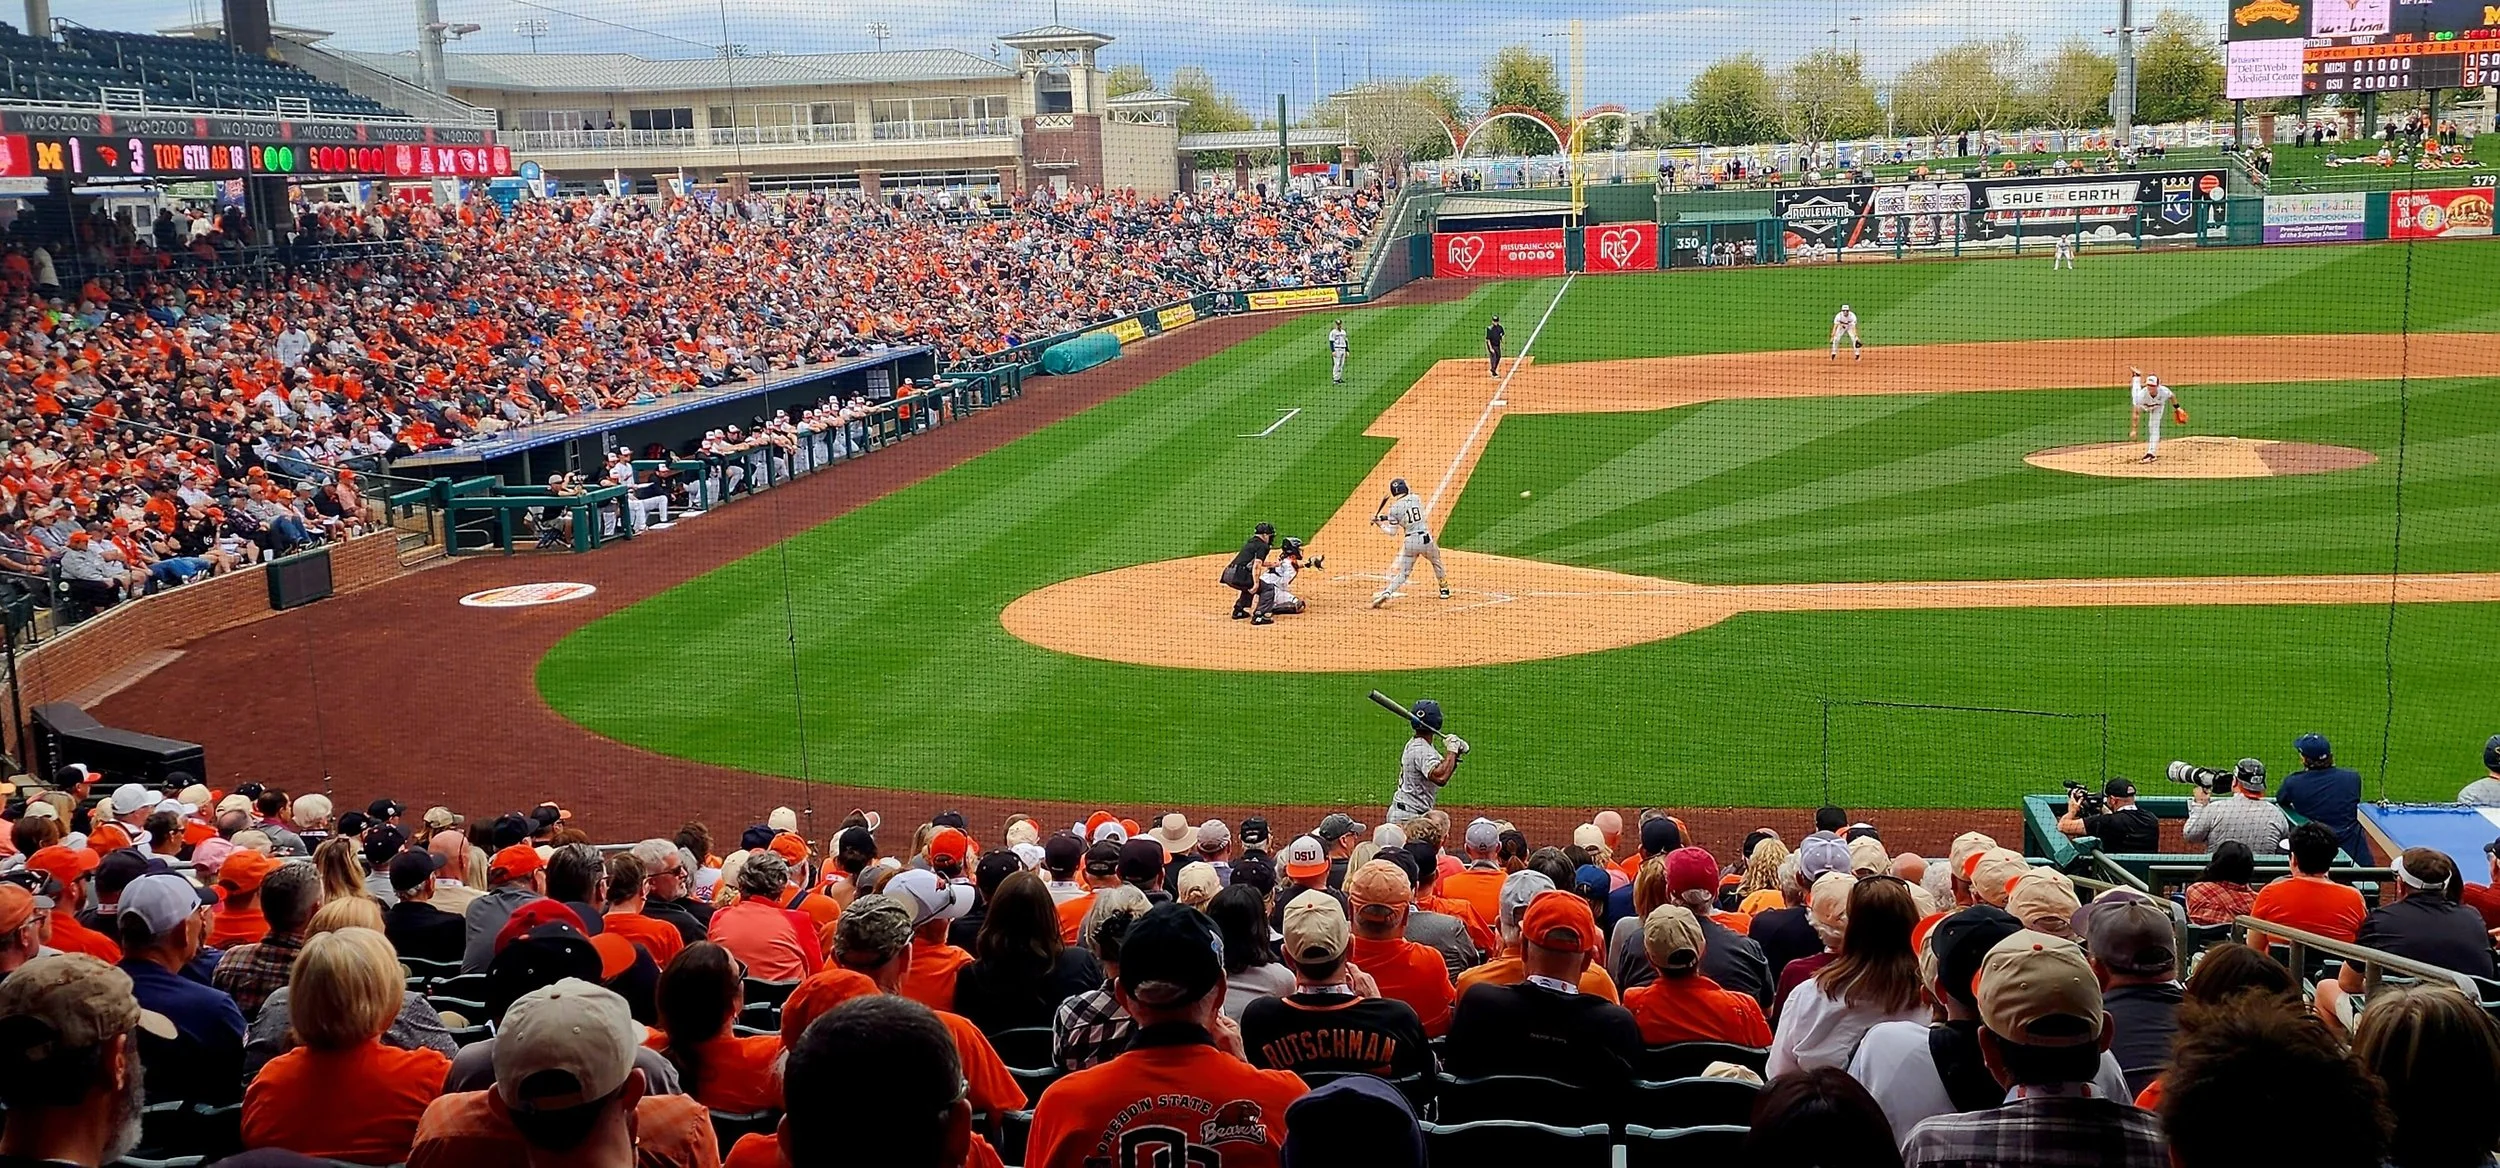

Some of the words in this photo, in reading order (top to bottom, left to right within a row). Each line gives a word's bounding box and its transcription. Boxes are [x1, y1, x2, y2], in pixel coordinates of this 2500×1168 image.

[2463, 30, 2470, 39] S
[2304, 38, 2332, 48] PITCHER
[2368, 47, 2374, 55] 2
[2380, 46, 2386, 55] 3
[2392, 46, 2398, 54] 4
[2404, 45, 2410, 53] 5
[2416, 45, 2423, 53] 6
[2440, 43, 2446, 51] 8
[2469, 42, 2475, 50] R
[2482, 41, 2488, 49] H
[2494, 40, 2500, 48] E
[2238, 64, 2252, 73] Del
[2263, 63, 2287, 72] Webb
[2303, 62, 2318, 73] M
[2324, 62, 2346, 73] MICH
[2353, 60, 2362, 72] 0
[2367, 60, 2373, 71] 1
[2377, 59, 2386, 71] 0
[2390, 58, 2398, 70] 0
[2402, 58, 2410, 70] 0
[2468, 54, 2475, 66] 1
[2480, 53, 2488, 66] 5
[2491, 53, 2500, 65] 0
[2238, 73, 2270, 83] Medical
[2272, 73, 2299, 81] Center
[2326, 79, 2343, 89] OSU
[2353, 77, 2361, 89] 2
[2365, 76, 2374, 88] 0
[2377, 76, 2386, 88] 0
[2389, 75, 2398, 87] 0
[2402, 74, 2409, 86] 1
[2466, 71, 2475, 84] 3
[2478, 70, 2487, 83] 7
[2491, 70, 2499, 83] 0
[20, 113, 90, 132] WOOZOO
[126, 119, 188, 134] WOOZOO
[220, 122, 274, 137] WOOZOO
[302, 125, 349, 140] WOOZOO
[376, 127, 419, 142] WOOZOO
[441, 130, 480, 143] WOOZOO
[36, 142, 64, 171] M
[68, 137, 83, 173] 1
[129, 138, 145, 173] 3
[153, 144, 182, 170] TOP
[183, 144, 210, 170] 6TH
[211, 145, 230, 169] AB
[230, 145, 245, 170] 18
[250, 145, 262, 169] B
[309, 146, 319, 169] S
[419, 147, 435, 173] A
[438, 148, 456, 173] M
[2471, 175, 2497, 186] 379
[2002, 192, 2044, 205] SAVE
[2048, 192, 2064, 200] THE
[2068, 188, 2120, 201] EARTH
[2165, 194, 2190, 217] KC
[2297, 231, 2322, 239] Surprise
[2325, 224, 2348, 232] Partner
[1500, 241, 1563, 251] IRISUSAINC.COM
[1676, 237, 1699, 249] 350
[1405, 506, 1422, 524] 18
[1294, 850, 1316, 861] OSU
[1262, 1028, 1397, 1069] RUTSCHMAN
[1096, 1096, 1154, 1153] OREGON
[1157, 1094, 1213, 1116] STATE
[1203, 1121, 1265, 1145] Beavers
